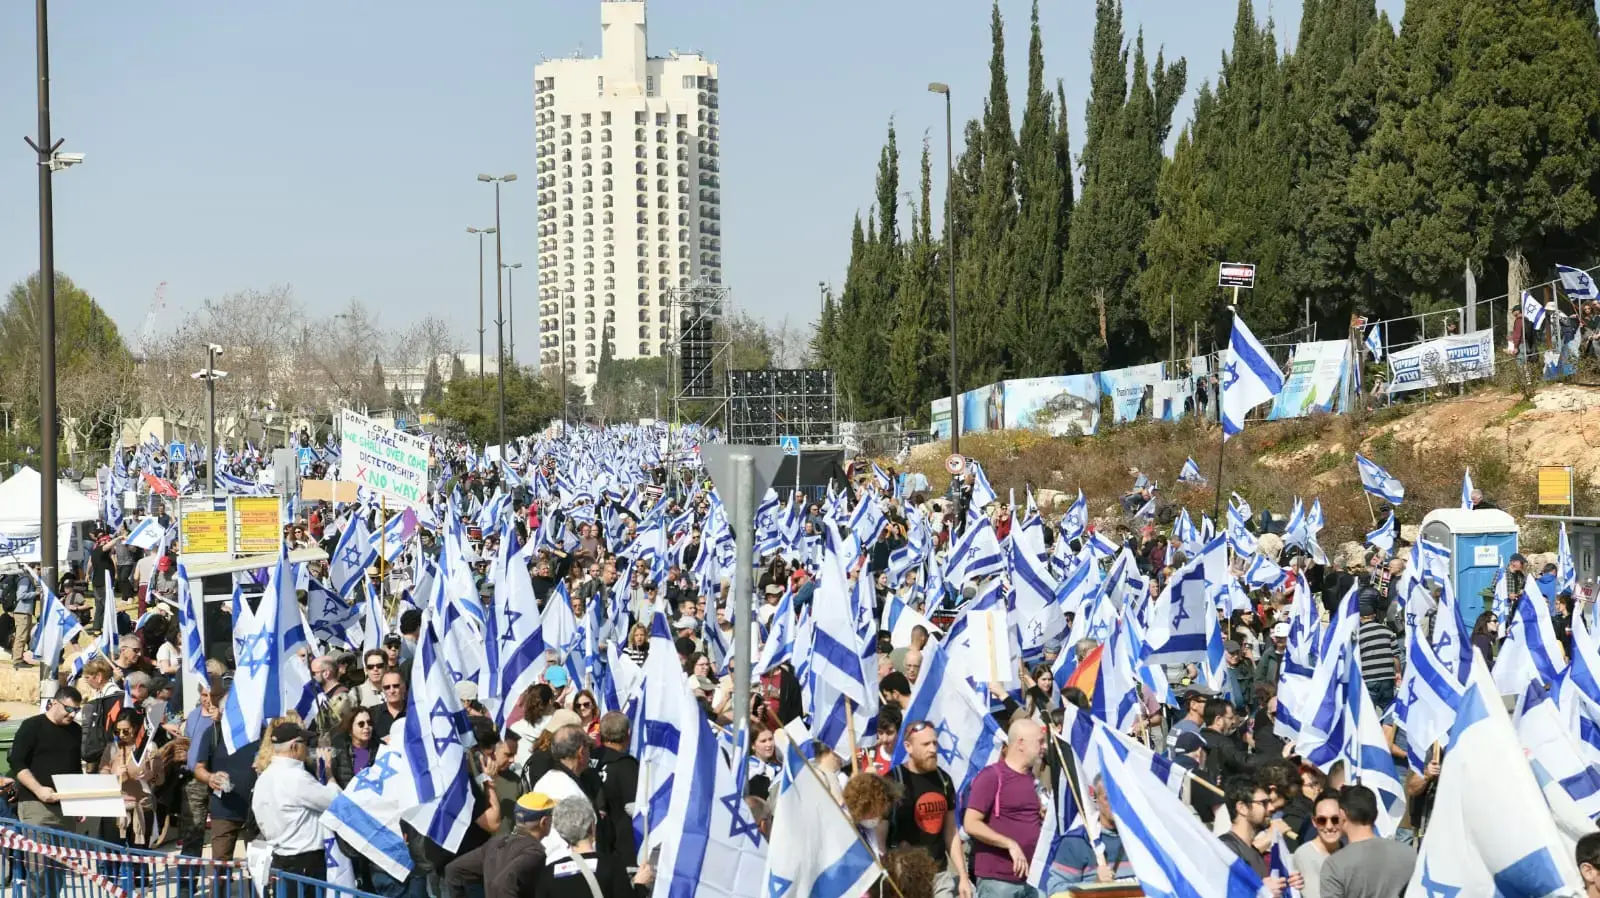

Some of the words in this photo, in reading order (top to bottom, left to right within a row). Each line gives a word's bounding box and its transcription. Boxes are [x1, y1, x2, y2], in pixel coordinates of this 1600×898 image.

[343, 430, 358, 443] WE
[360, 436, 383, 455] SHALL
[386, 447, 406, 464] OVER
[407, 454, 427, 472] COME
[367, 430, 398, 449] ISRAEL
[372, 424, 389, 436] CRY
[393, 433, 408, 444] FOR
[412, 440, 425, 451] ME
[368, 470, 388, 489] NO
[391, 478, 418, 501] WAY
